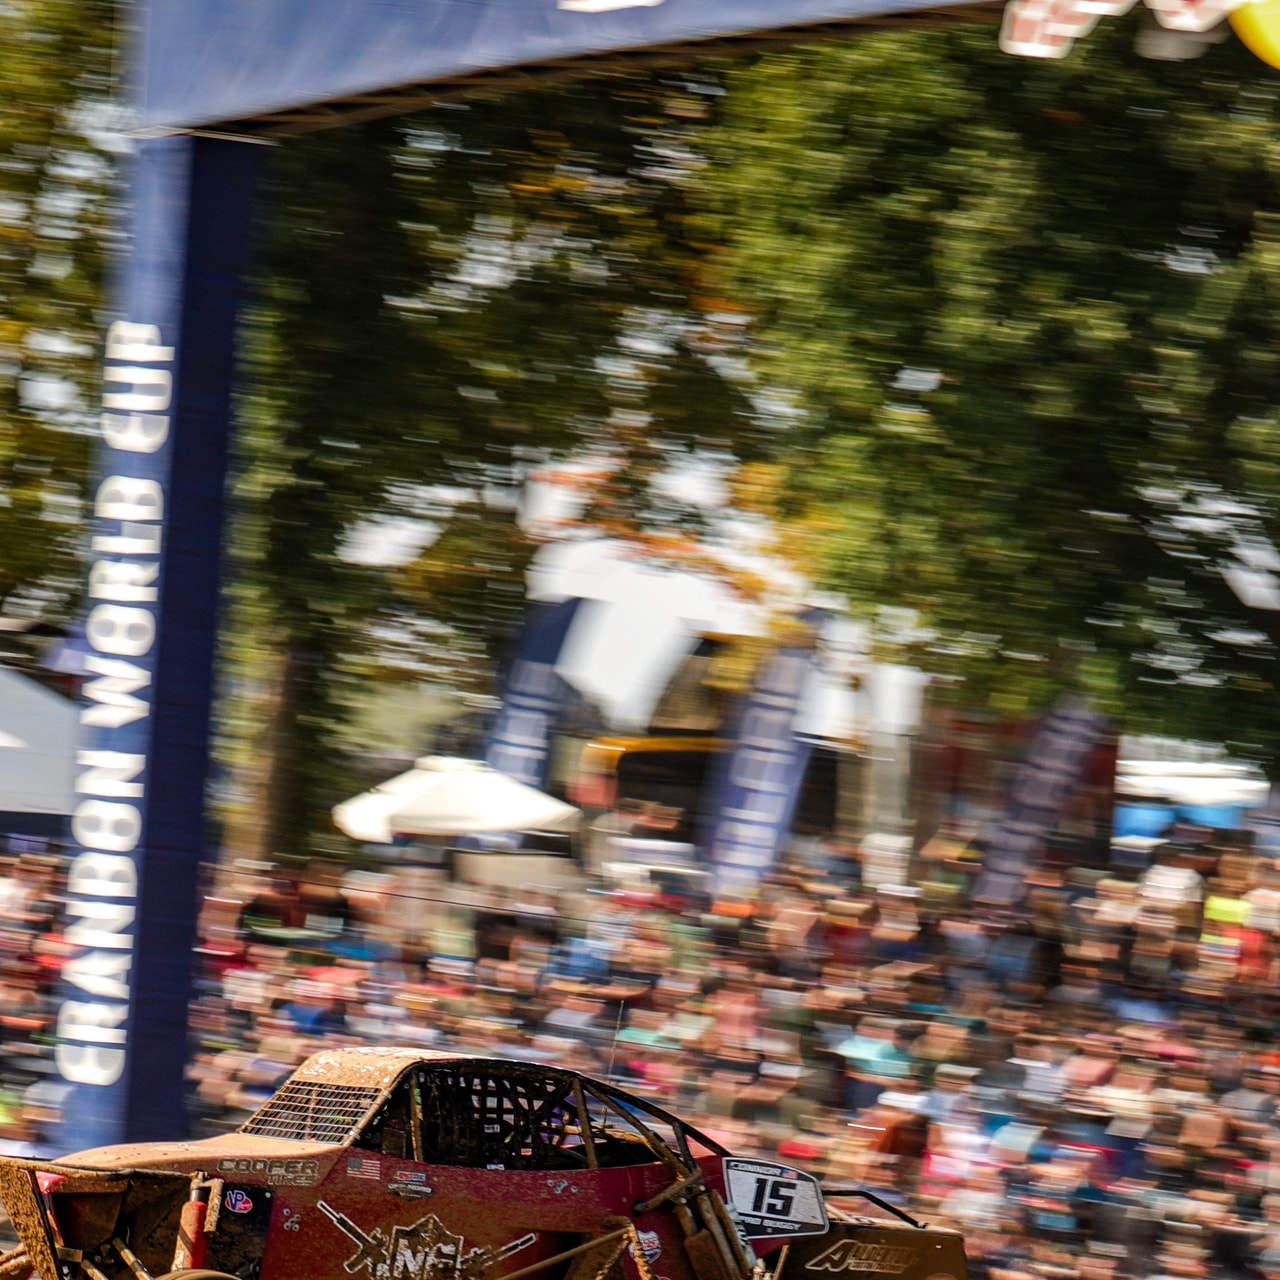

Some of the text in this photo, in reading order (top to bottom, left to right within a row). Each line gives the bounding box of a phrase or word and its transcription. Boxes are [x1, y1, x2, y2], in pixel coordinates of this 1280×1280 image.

[55, 320, 176, 1086] CRANDON WORLD CUP
[216, 1158, 319, 1175] COOPER
[226, 1190, 246, 1212] VP
[752, 1178, 797, 1217] 15
